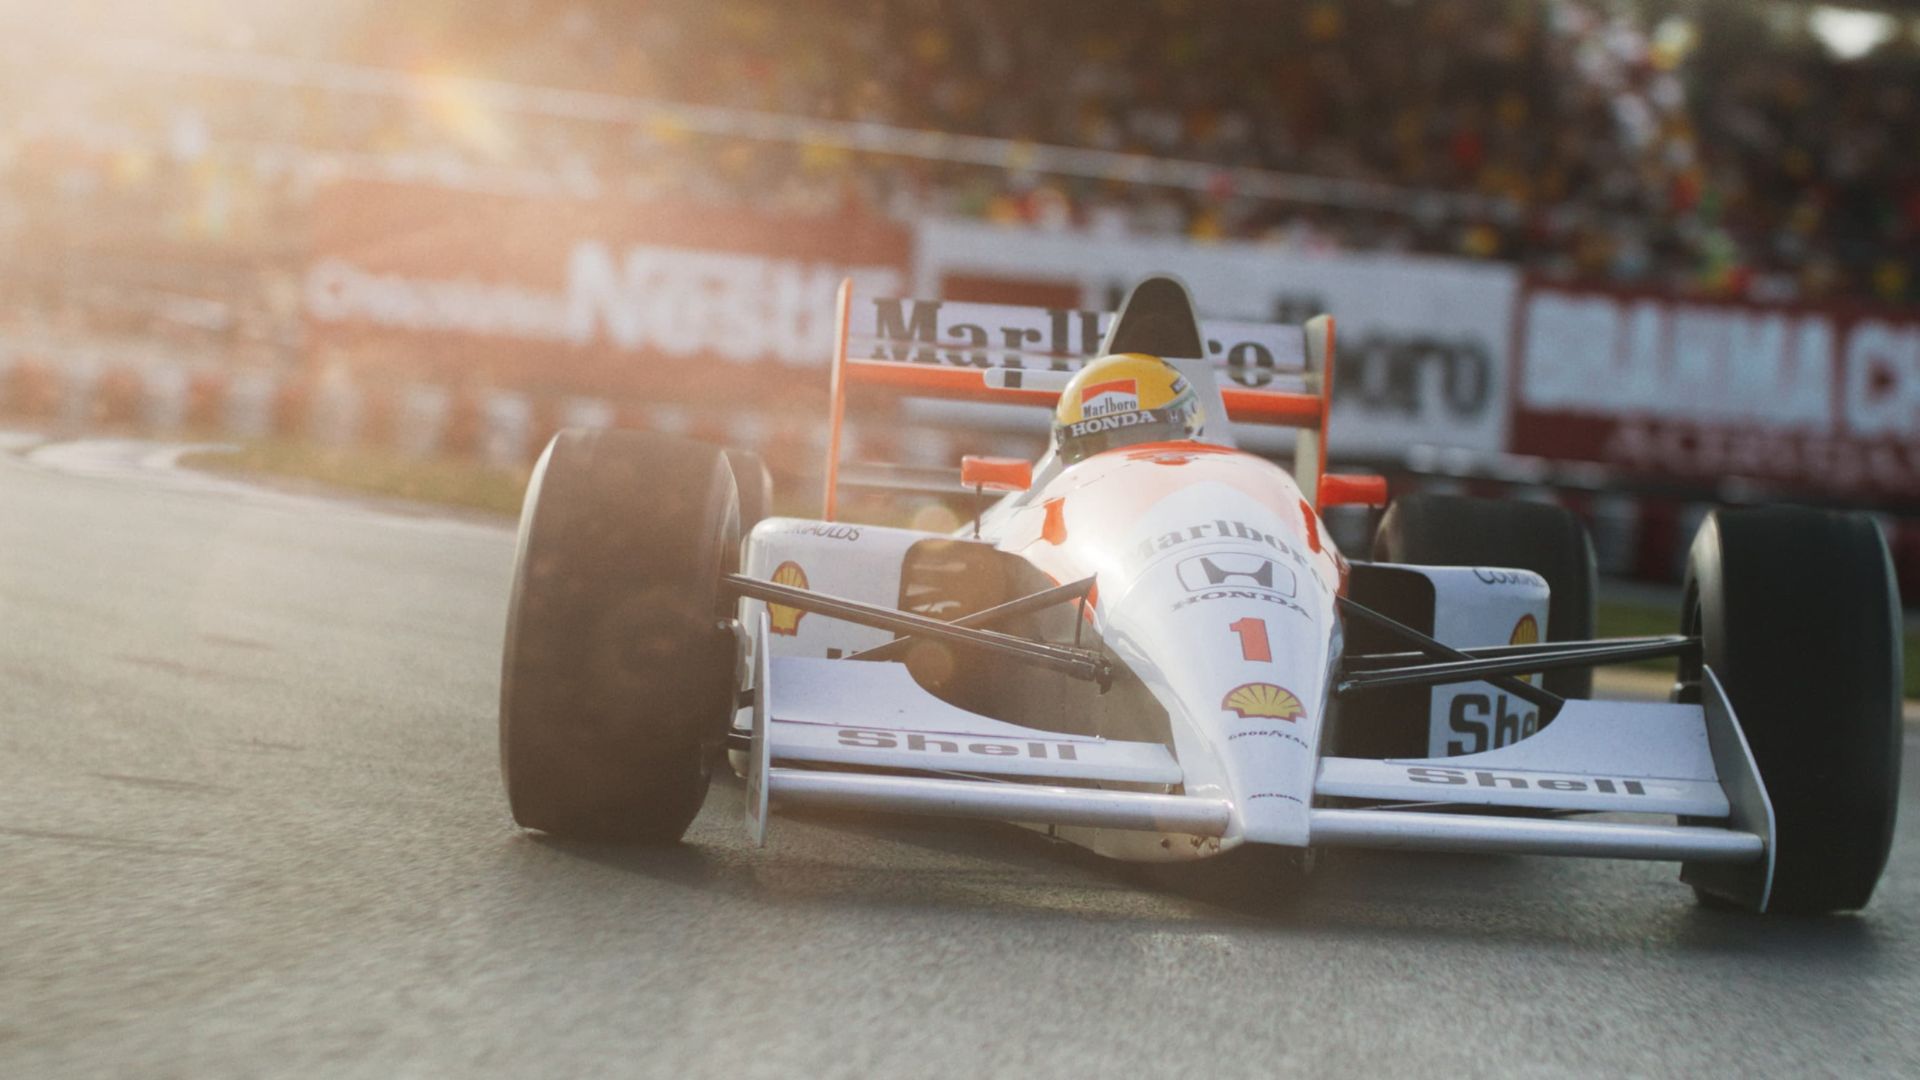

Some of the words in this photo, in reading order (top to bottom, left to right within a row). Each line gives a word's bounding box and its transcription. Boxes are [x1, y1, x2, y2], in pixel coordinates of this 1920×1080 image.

[871, 297, 1275, 388] Marlo
[1070, 410, 1157, 437] HONDA
[1083, 397, 1137, 419] Marlboro
[1169, 590, 1313, 622] HONDA
[1229, 616, 1273, 663] 1
[1447, 693, 1538, 758] She
[837, 729, 1078, 761] Shell
[1407, 767, 1646, 796] Shell
